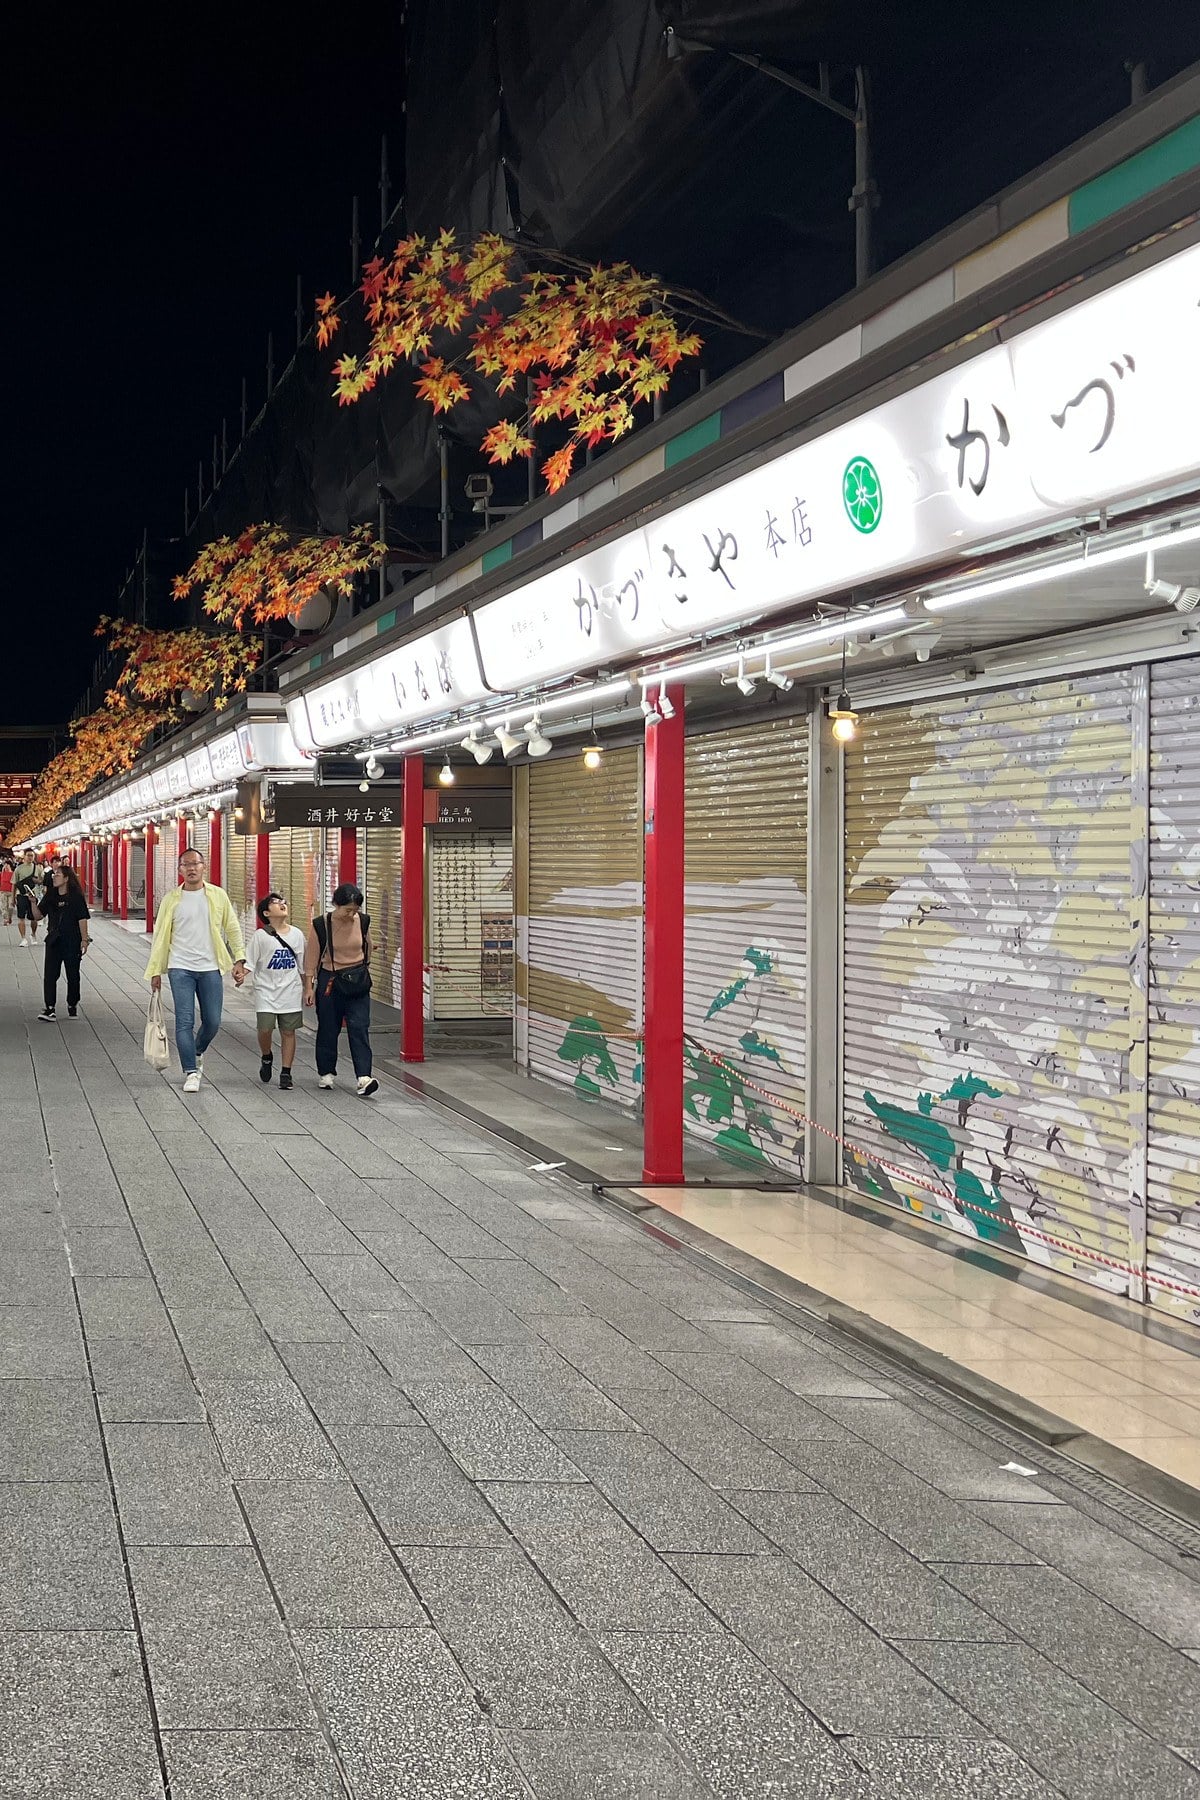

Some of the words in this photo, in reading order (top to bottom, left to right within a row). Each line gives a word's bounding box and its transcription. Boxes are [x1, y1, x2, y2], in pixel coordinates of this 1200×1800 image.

[763, 496, 812, 559] 本店
[391, 650, 455, 710] いなば
[307, 807, 339, 823] 酒井
[343, 806, 394, 822] 好古堂
[272, 948, 295, 958] STA
[267, 958, 296, 969] WARS
